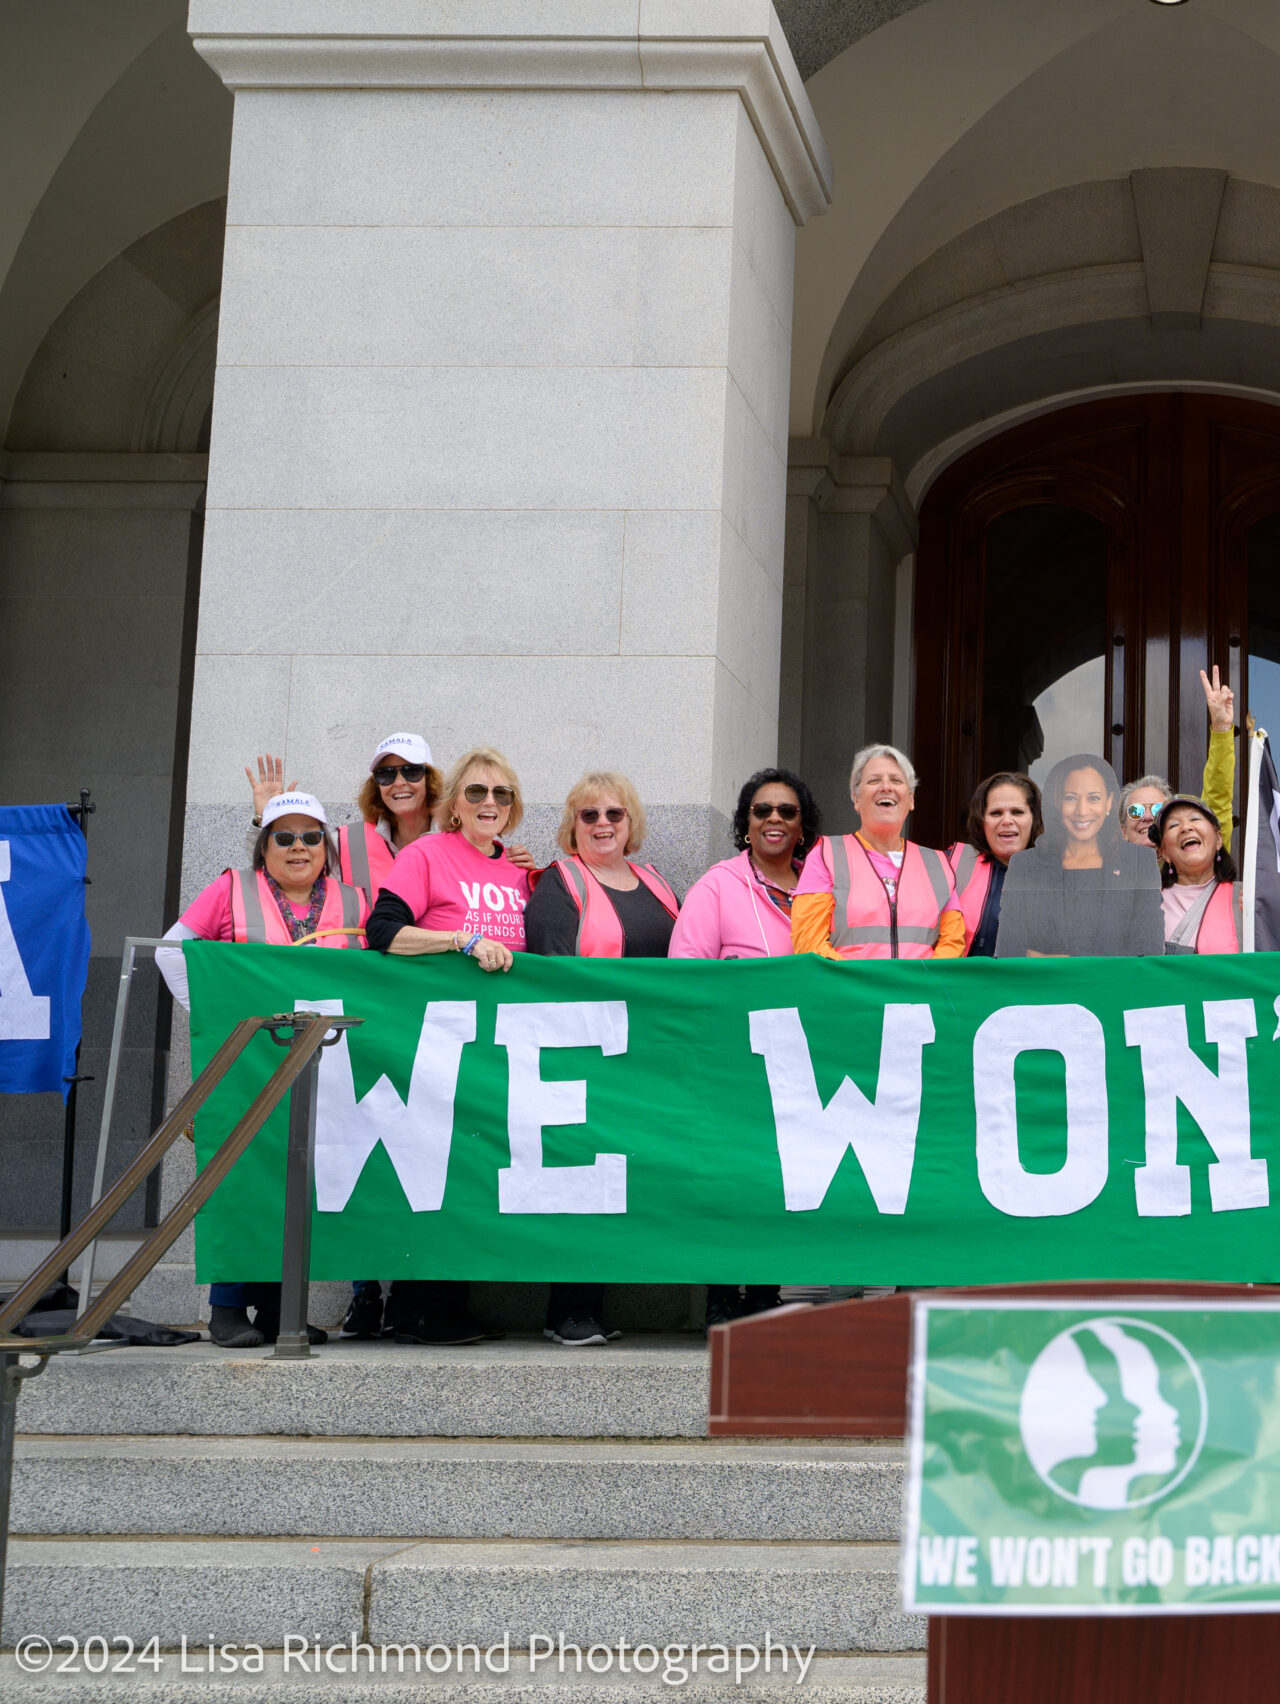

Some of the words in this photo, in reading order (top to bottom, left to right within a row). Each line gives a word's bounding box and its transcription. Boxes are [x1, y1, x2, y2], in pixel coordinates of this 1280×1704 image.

[276, 798, 310, 807] KAMALA
[465, 910, 480, 922] AS
[483, 912, 492, 923] IF
[495, 913, 521, 925] YOUR
[463, 922, 516, 938] DEPENDS
[294, 999, 628, 1214] WE
[918, 1535, 978, 1587] WE
[989, 1535, 1112, 1587] WON'T
[1122, 1535, 1174, 1587] GO
